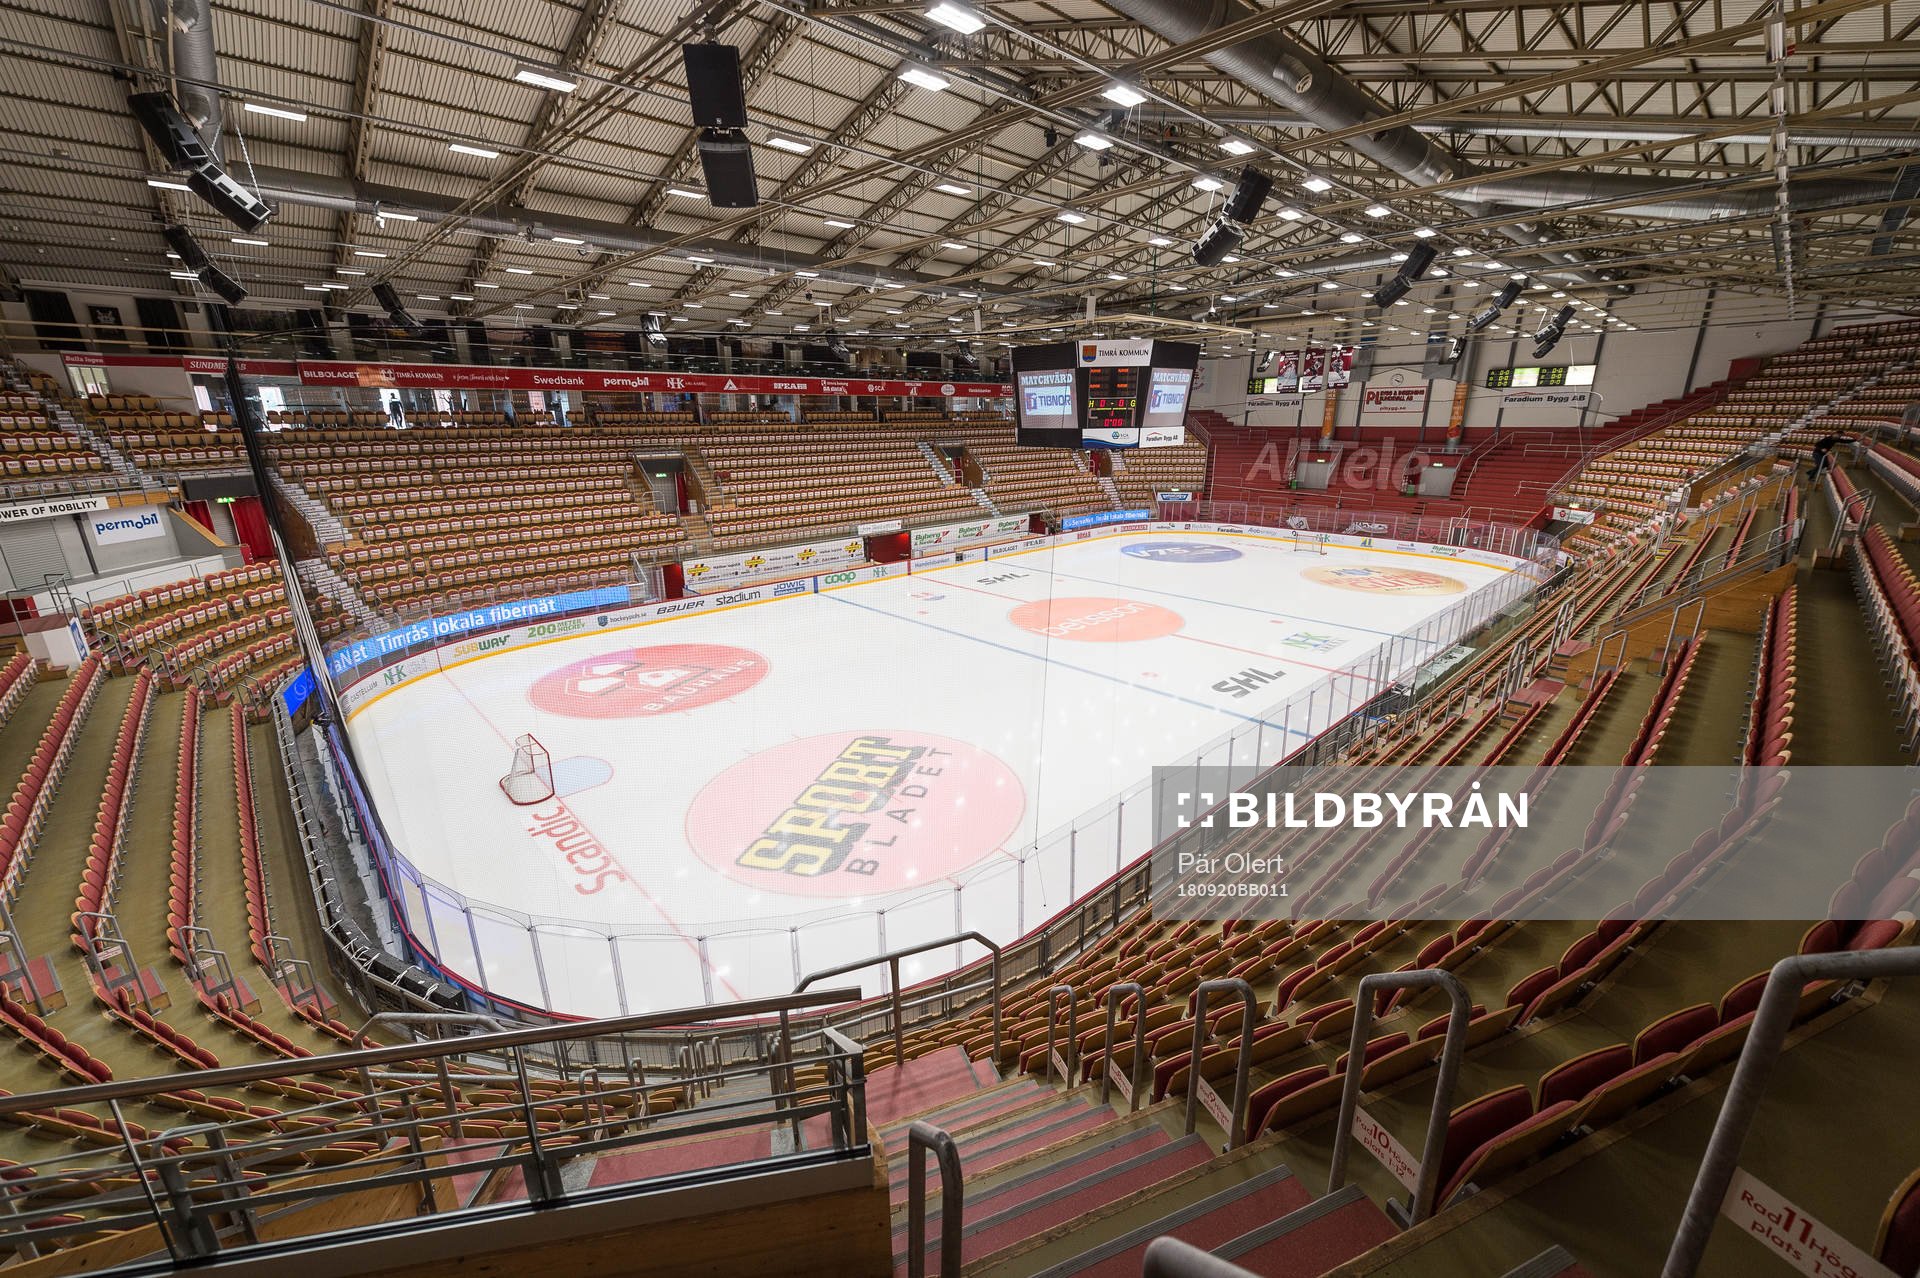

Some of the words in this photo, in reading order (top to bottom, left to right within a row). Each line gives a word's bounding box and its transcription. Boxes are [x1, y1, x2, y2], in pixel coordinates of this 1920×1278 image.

[1099, 349, 1117, 357] TIMRÅ
[1119, 349, 1149, 357] KOMMUN
[190, 360, 229, 371] SUNDME
[303, 369, 360, 380] BILBOLAGET
[396, 371, 414, 379] TIMRÅ
[415, 371, 444, 380] KOMMUN
[533, 375, 584, 386] Swedbank
[603, 376, 649, 387] permobil
[666, 377, 685, 389] NHK
[1038, 394, 1071, 407] TIBNOR
[1088, 400, 1094, 408] H
[1130, 400, 1136, 408] G
[1275, 400, 1290, 408] Bygg
[1366, 391, 1381, 405] PL
[1547, 395, 1569, 404] Bygg
[1571, 394, 1586, 402] AB
[31, 506, 46, 515] OF
[49, 501, 97, 513] MOBILITY
[96, 513, 159, 535] permobil
[958, 525, 982, 534] Byberg
[999, 520, 1020, 528] Byberg
[915, 532, 941, 541] Byberg
[824, 571, 857, 584] coop
[976, 573, 1030, 586] SHL
[773, 580, 805, 591] JOWIC
[656, 599, 705, 616] BAUER
[376, 627, 429, 653] Timrås
[433, 612, 485, 636] lokala
[488, 599, 557, 622] fibernät
[1030, 600, 1158, 638] betsson
[527, 622, 557, 640] 200
[453, 634, 511, 658] SUBWAY
[383, 664, 408, 685] NHK
[642, 658, 756, 712] BAUHAUS
[1211, 667, 1287, 700] SHL
[350, 680, 378, 702] CASTELLUM
[734, 735, 929, 878] SPORT
[845, 746, 953, 877] BLADET
[527, 805, 627, 896] Scandic
[1372, 1123, 1390, 1149] 10
[1388, 1146, 1416, 1178] Höger
[1741, 1189, 1783, 1226] Rad
[1782, 1206, 1814, 1246] 11
[1808, 1237, 1864, 1278] Hög
[1751, 1220, 1803, 1262] plats
